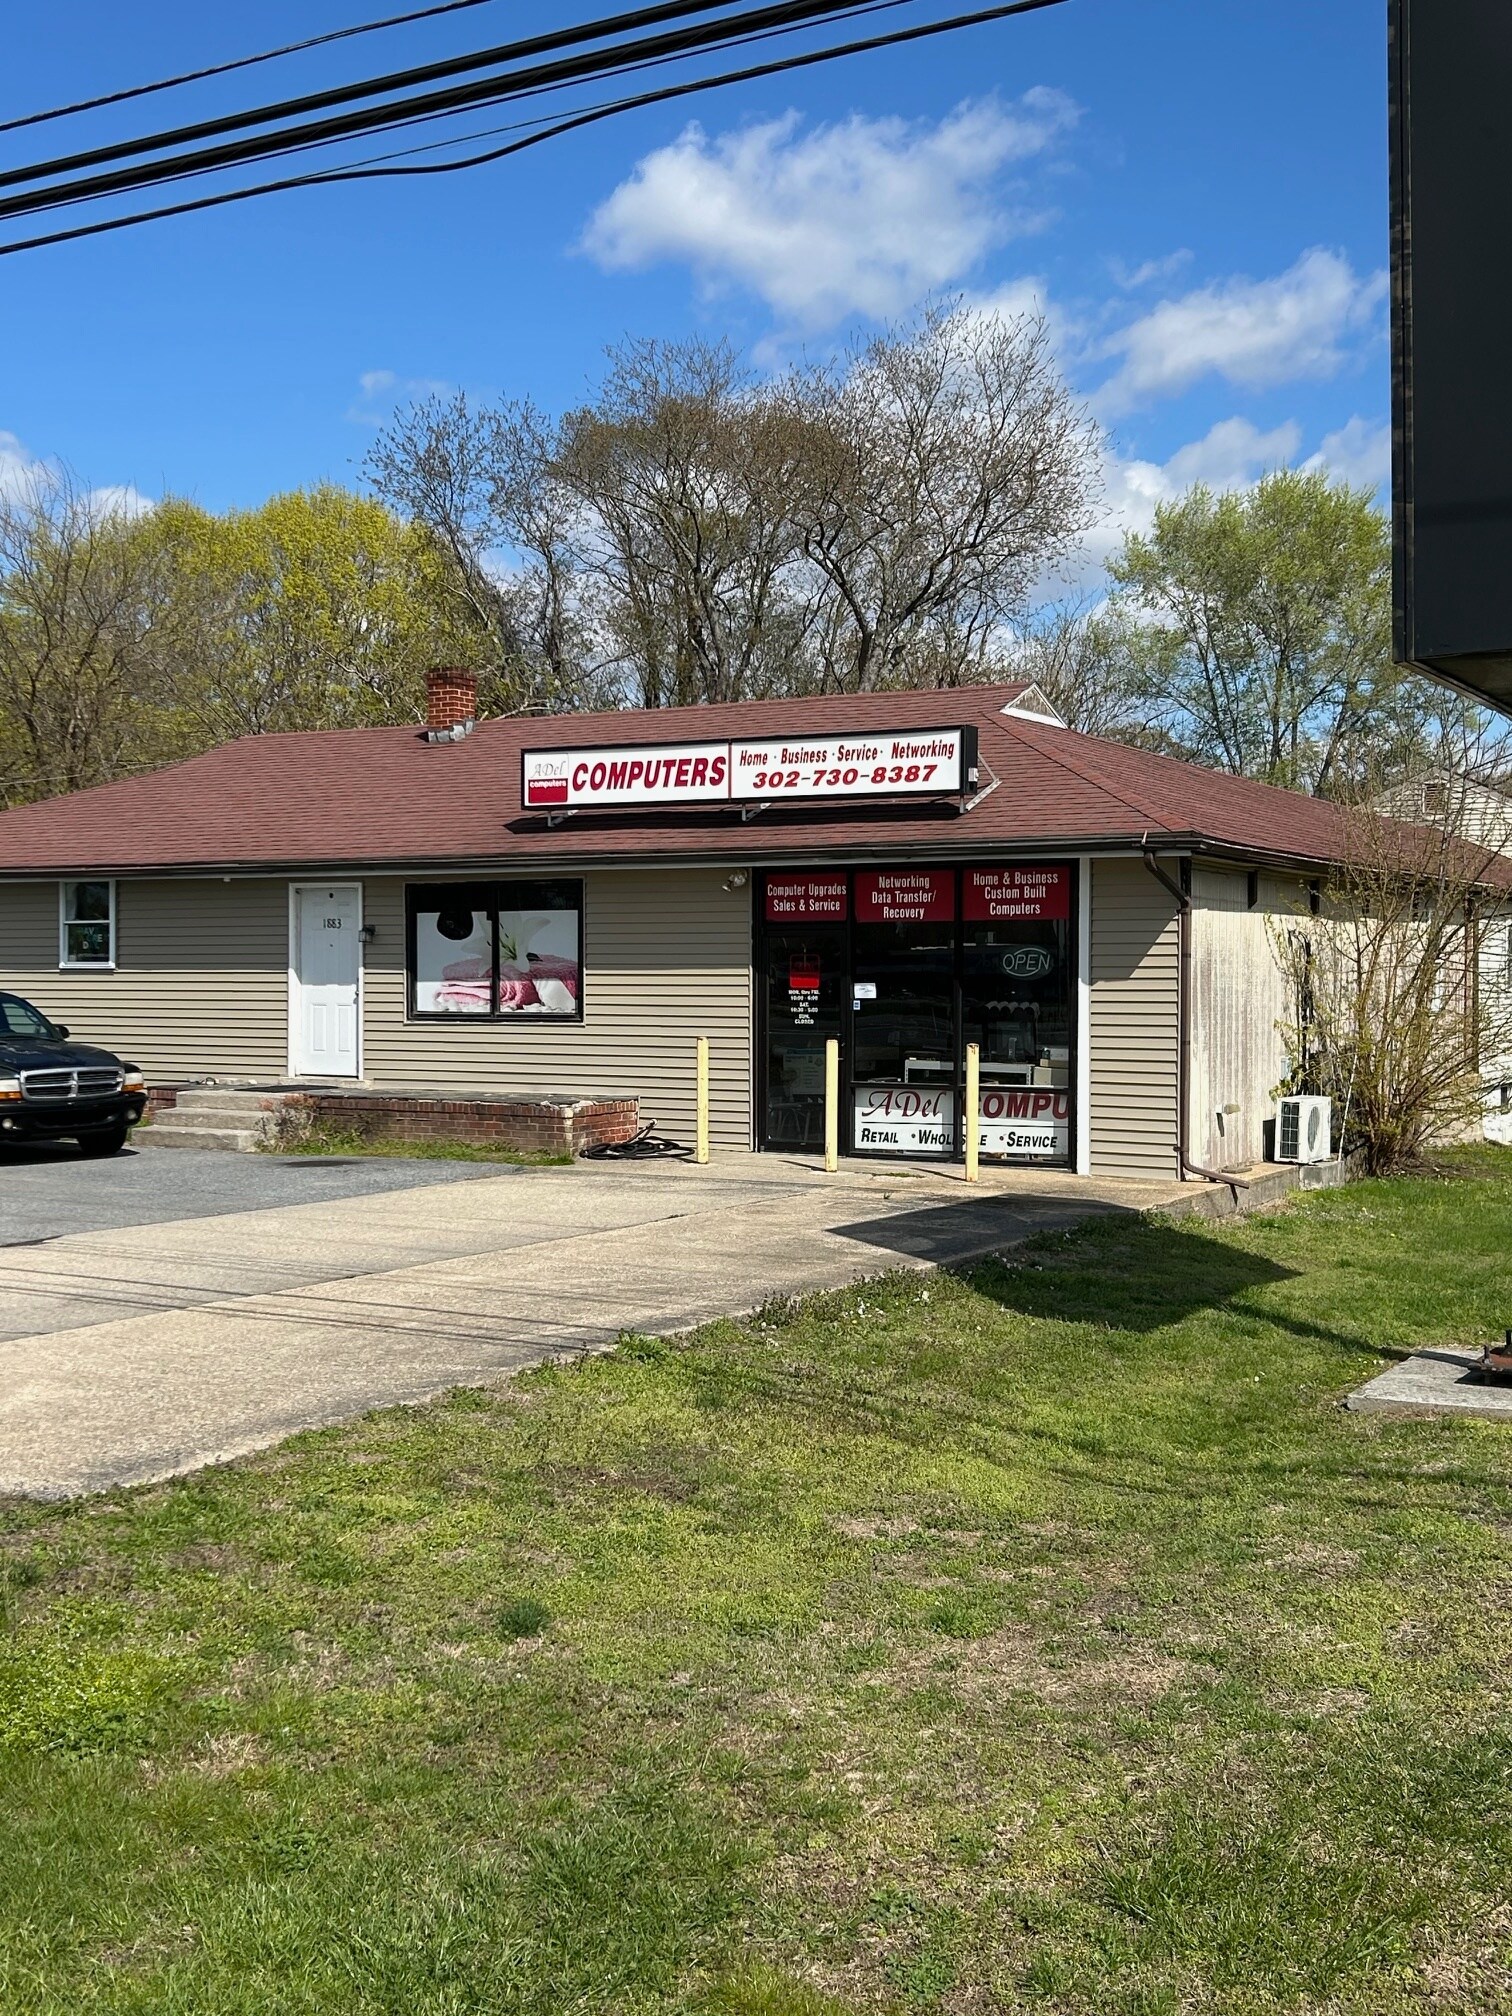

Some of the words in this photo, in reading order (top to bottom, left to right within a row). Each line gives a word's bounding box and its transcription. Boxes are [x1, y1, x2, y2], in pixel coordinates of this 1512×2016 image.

[739, 750, 768, 766] Home
[781, 747, 827, 765] Business
[837, 744, 878, 762] Service
[891, 740, 955, 760] Networking
[572, 756, 727, 791] COMPUTERS
[753, 764, 938, 789] 302-730-8387
[529, 780, 567, 789] computers
[878, 876, 930, 889] Networking
[973, 873, 999, 886] Home
[1003, 872, 1011, 885] &
[1015, 871, 1059, 885] Business
[767, 884, 806, 898] Computer
[808, 883, 847, 897] Upgrades
[872, 891, 892, 904] Data
[894, 890, 937, 904] Transfer/
[984, 886, 1020, 899] Custom
[1023, 885, 1046, 899] Built
[773, 899, 796, 912] Sales
[799, 899, 806, 912] &
[809, 899, 840, 912] Service
[989, 902, 1041, 917] Computers
[883, 906, 925, 920] Recovery
[322, 918, 342, 929] 1883
[1002, 953, 1051, 971] OPEN
